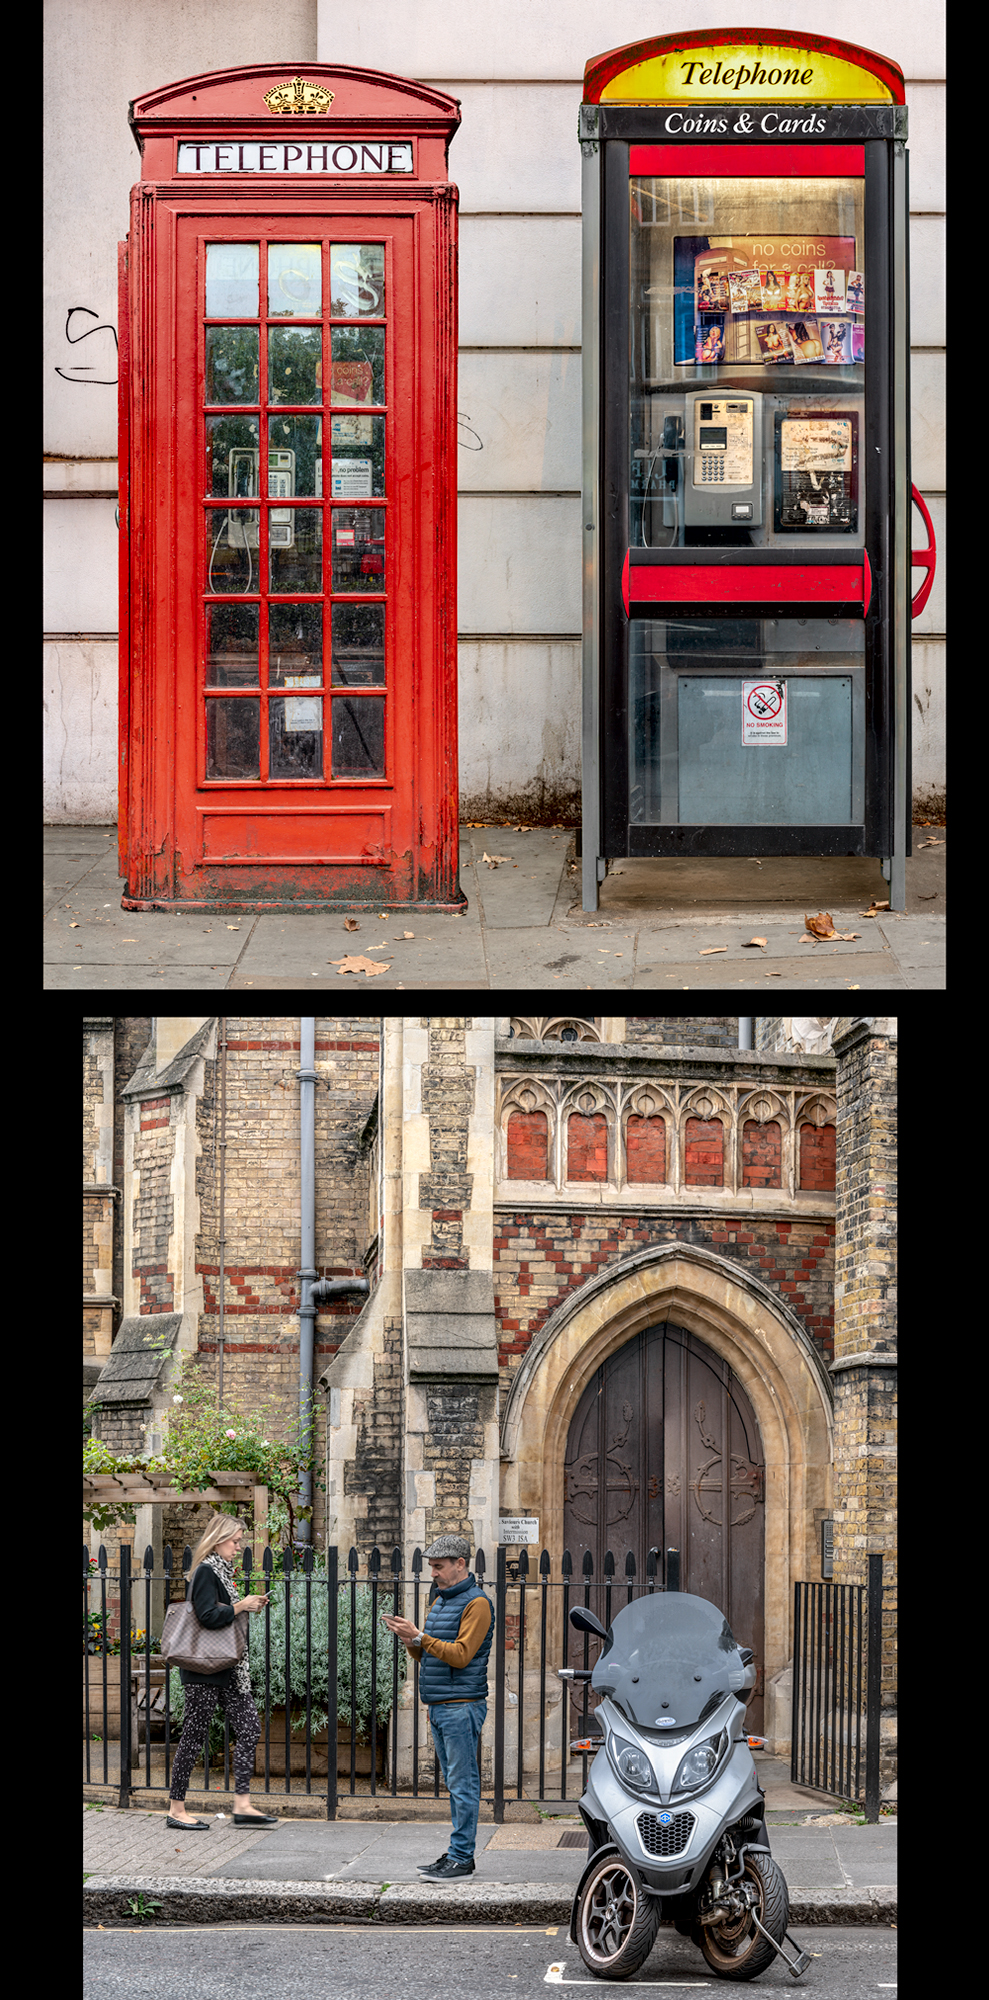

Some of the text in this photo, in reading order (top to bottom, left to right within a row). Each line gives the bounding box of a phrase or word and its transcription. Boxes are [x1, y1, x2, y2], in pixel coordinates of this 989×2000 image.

[680, 61, 814, 91] Telephone
[664, 112, 827, 134] Coins & Cards
[186, 145, 408, 171] TELEPHONE
[752, 240, 826, 257] no coins
[347, 466, 369, 474] problem
